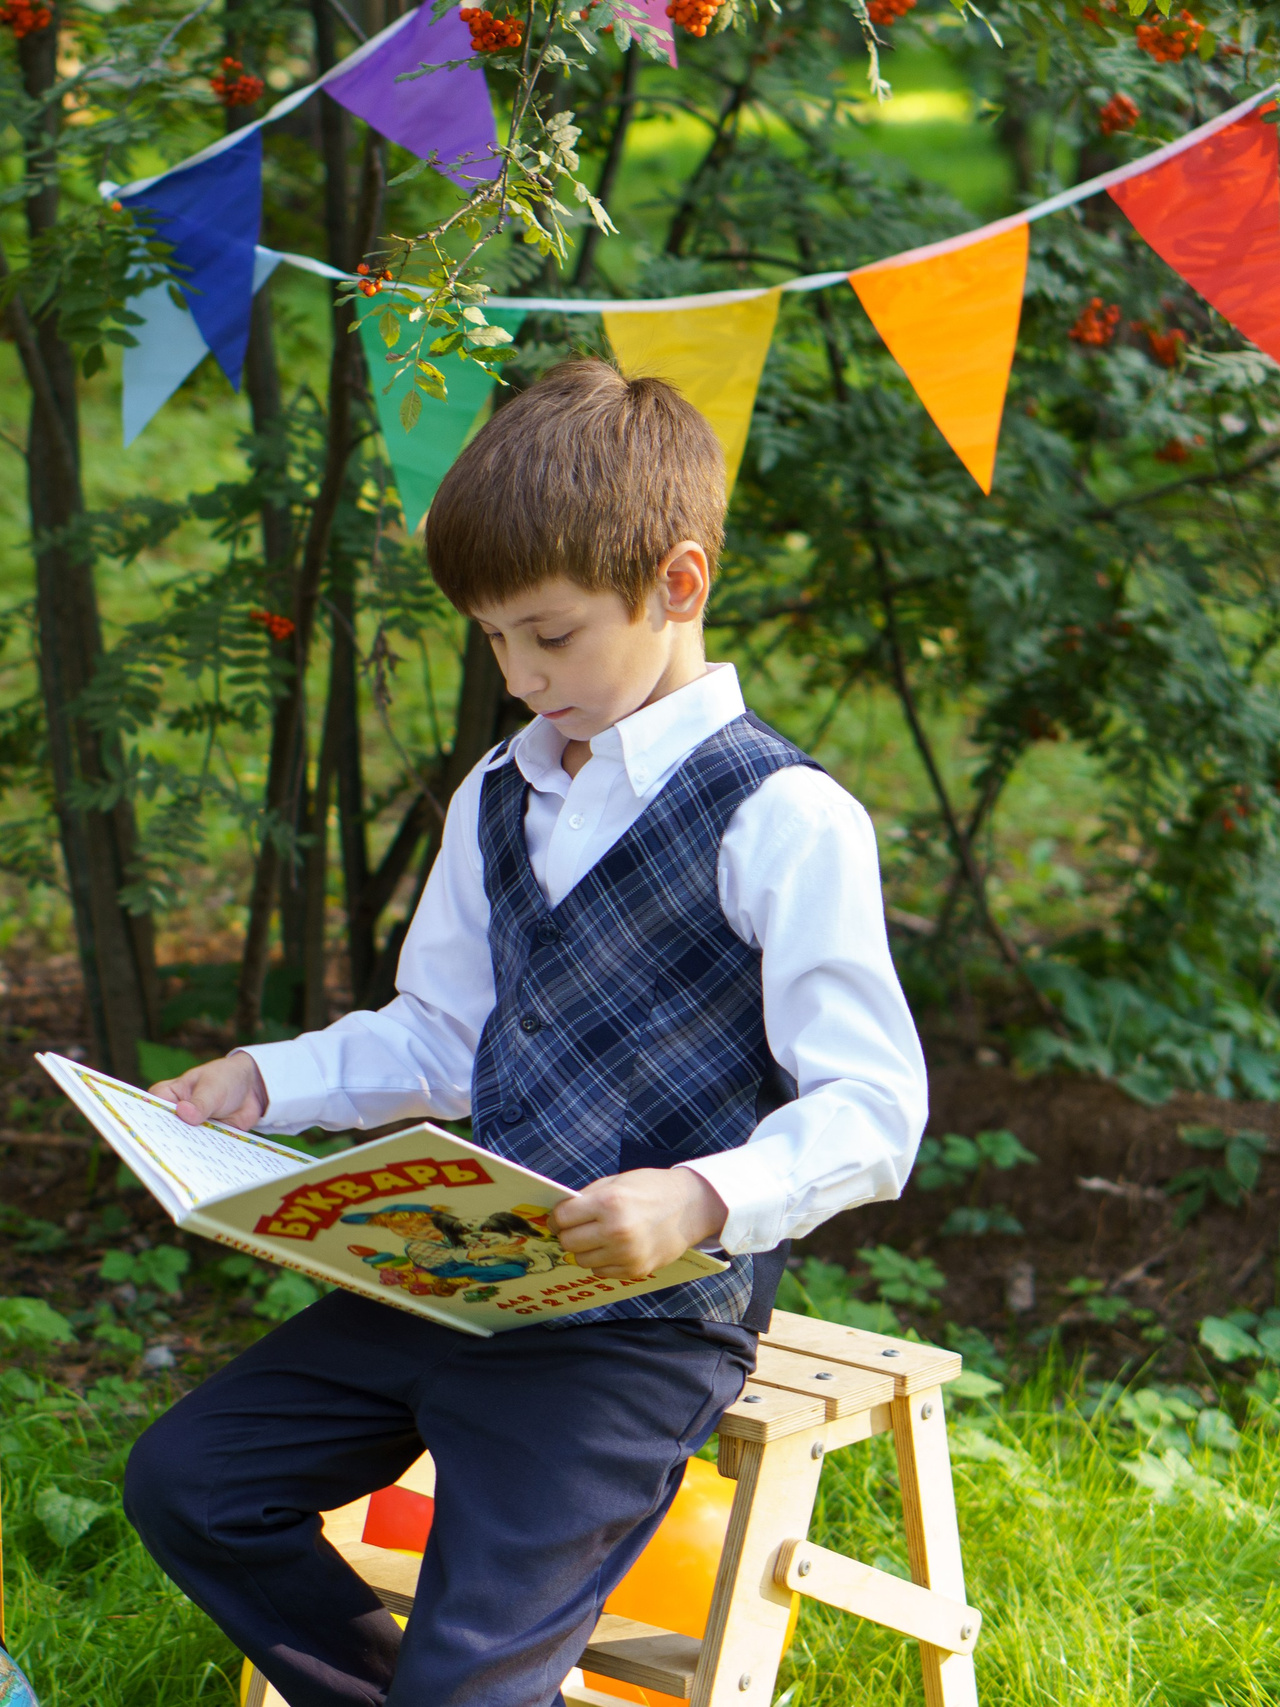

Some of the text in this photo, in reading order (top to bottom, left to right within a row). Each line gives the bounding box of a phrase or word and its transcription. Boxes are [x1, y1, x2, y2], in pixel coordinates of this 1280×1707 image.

[267, 1164, 478, 1237] БУКВАРЬ
[542, 1298, 564, 1307] 2
[594, 1283, 615, 1292] 5
